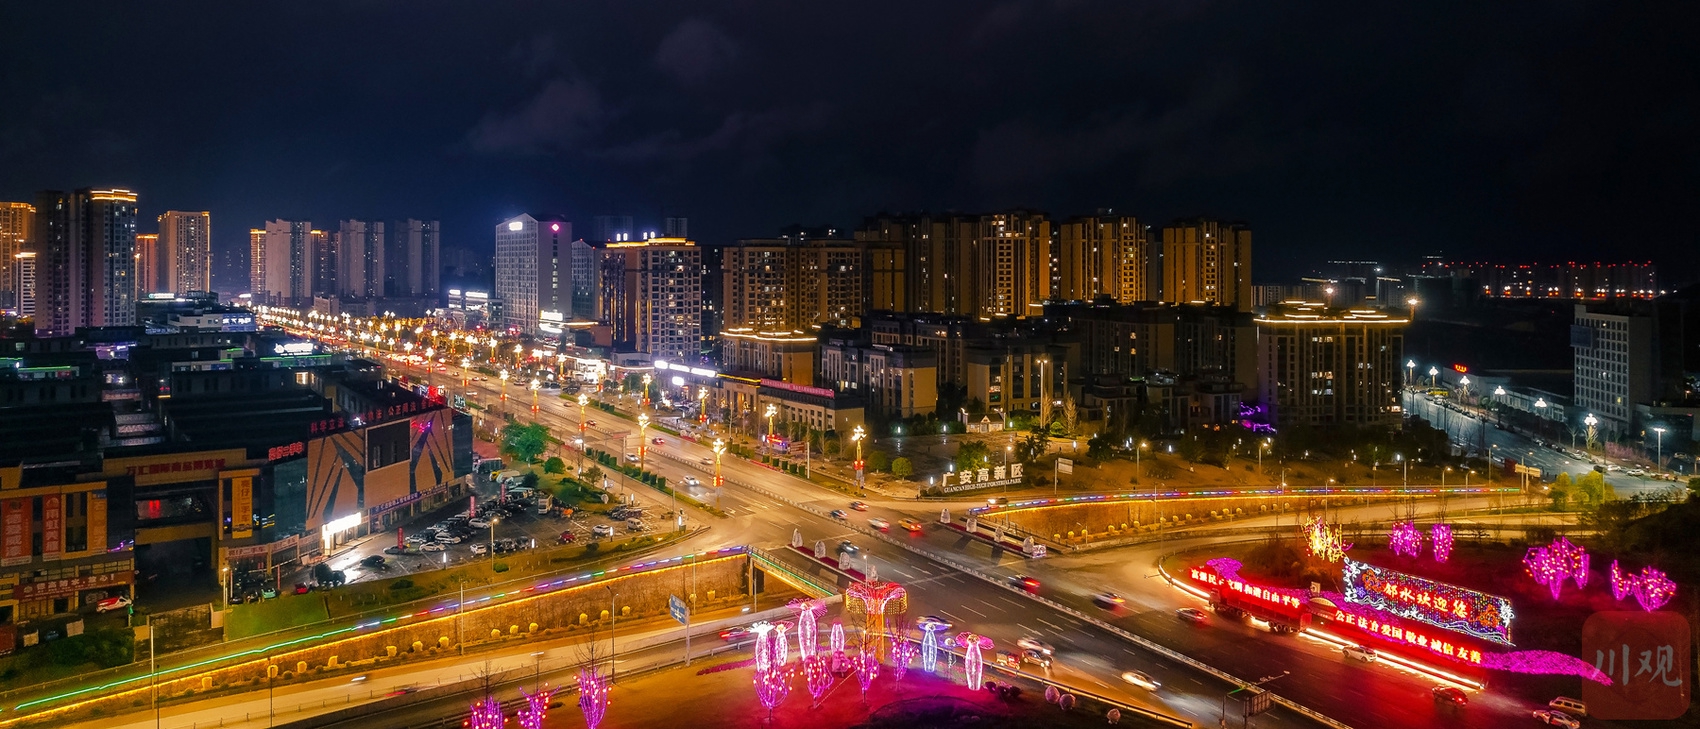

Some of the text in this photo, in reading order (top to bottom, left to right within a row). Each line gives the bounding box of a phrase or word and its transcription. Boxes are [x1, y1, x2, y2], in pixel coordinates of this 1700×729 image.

[942, 463, 1023, 487] 广安高新区
[1383, 582, 1468, 618] 邻水欢迎您
